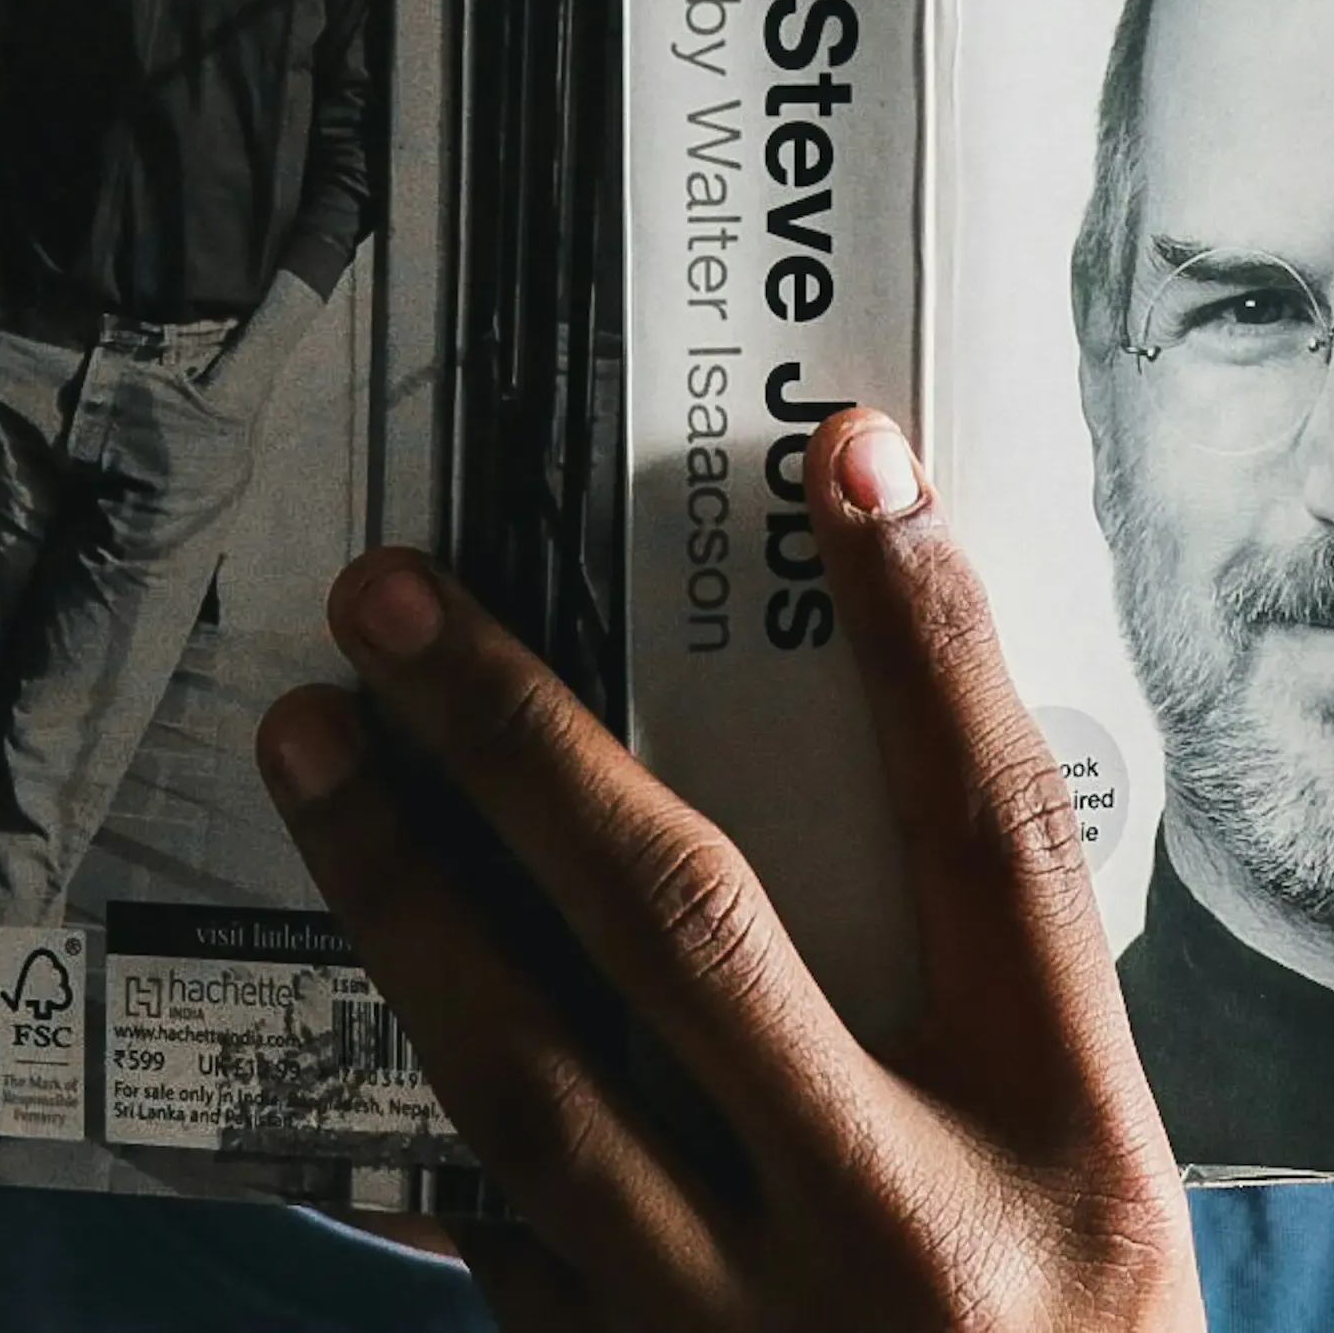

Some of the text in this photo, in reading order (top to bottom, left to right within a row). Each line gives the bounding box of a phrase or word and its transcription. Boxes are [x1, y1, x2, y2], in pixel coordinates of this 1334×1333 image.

[685, 99, 742, 321] Walter
[685, 346, 742, 655] Isaacson
[169, 969, 292, 1008] hachette
[12, 1025, 72, 1047] FSC
[114, 1081, 139, 1098] For
[144, 1083, 175, 1100] sale
[179, 1085, 215, 1106] only
